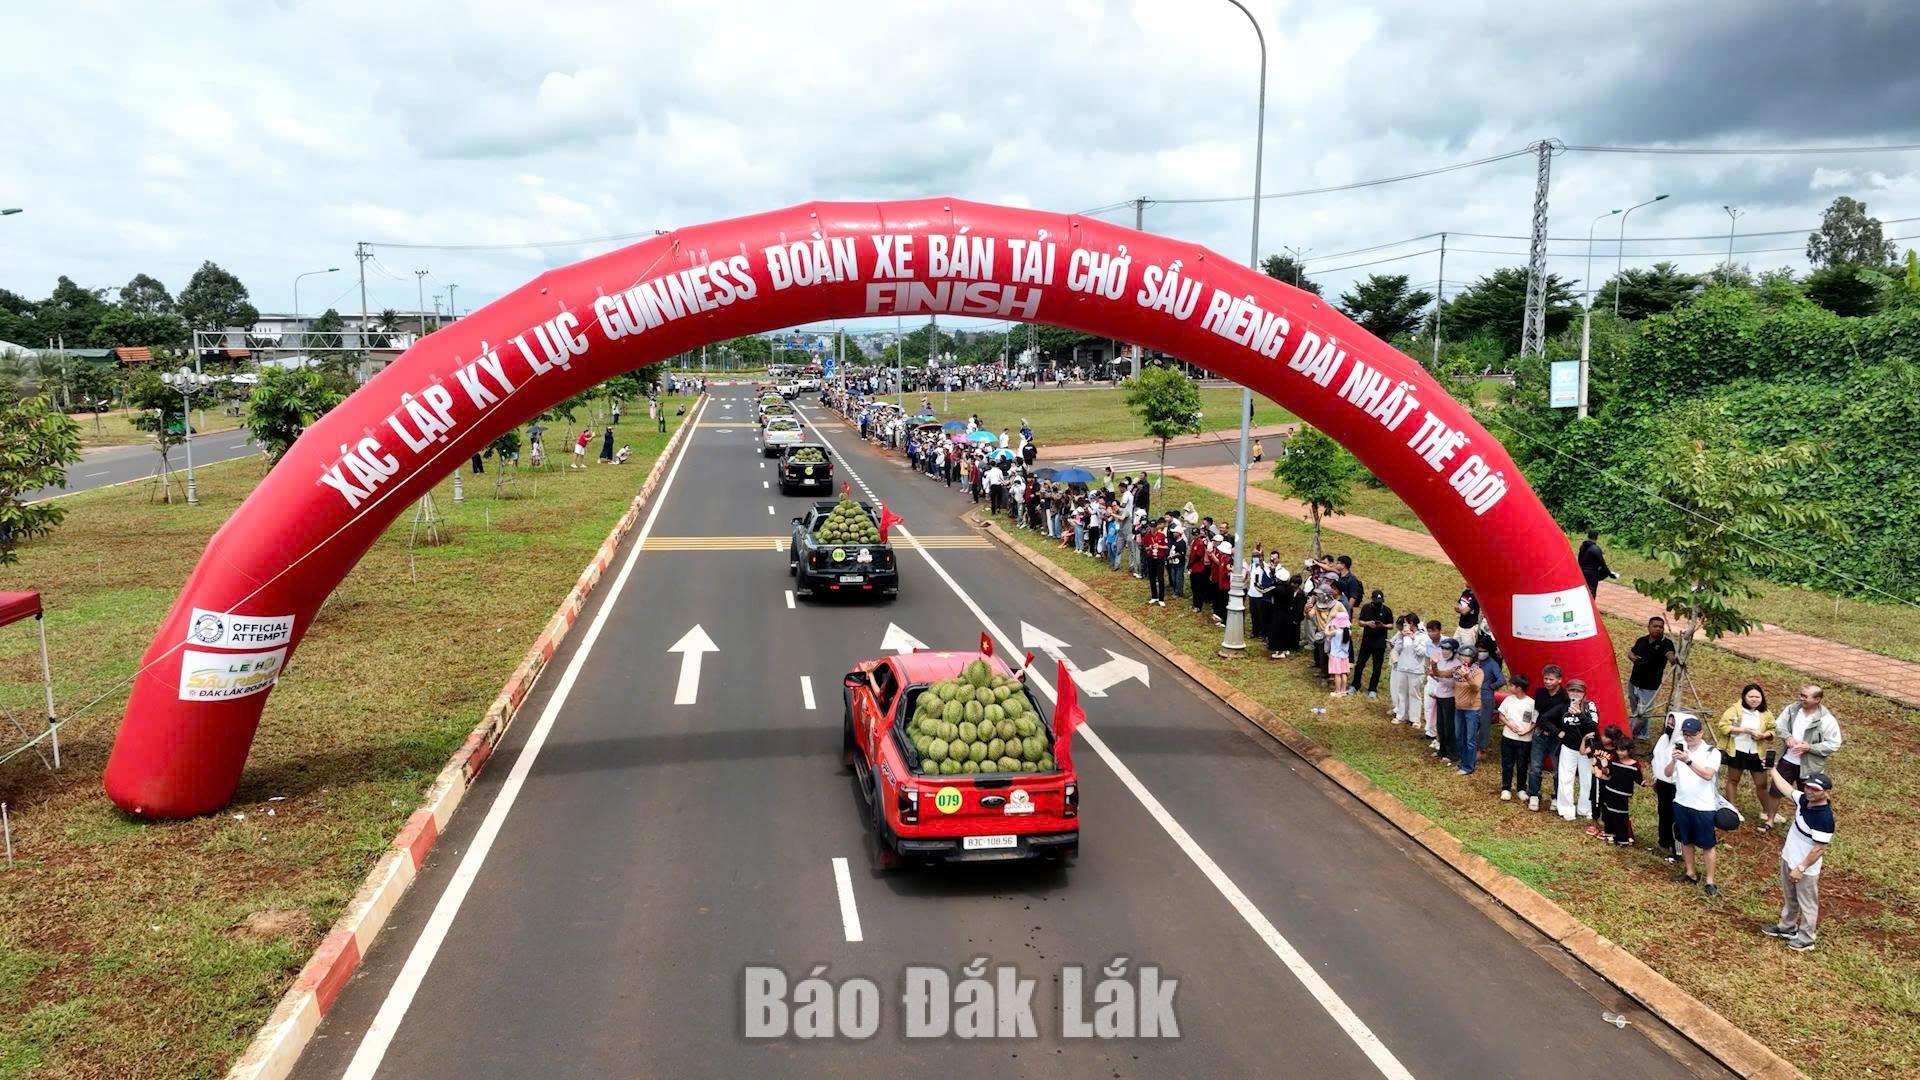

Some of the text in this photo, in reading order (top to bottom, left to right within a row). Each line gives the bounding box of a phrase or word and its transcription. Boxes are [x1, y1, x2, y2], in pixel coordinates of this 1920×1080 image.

[865, 281, 1043, 319] FINISH
[320, 443, 400, 509] XÁC
[387, 384, 457, 454] LẬP
[514, 312, 589, 376] LỤC
[594, 255, 758, 341] GUINNESS
[765, 231, 859, 291] ĐOÀN
[872, 235, 914, 279] XE
[928, 226, 995, 281] BÁN
[1008, 229, 1056, 285] TẢI
[1067, 245, 1132, 300] CHỞ
[1137, 259, 1203, 321] SẦU
[1200, 289, 1290, 360] RIÊNG
[1287, 330, 1347, 388] DÀI
[1337, 360, 1421, 432] NHẤT
[1407, 411, 1471, 473] THẾ
[1448, 454, 1508, 517] GIỚI
[232, 622, 289, 632] OFFICIAL
[231, 631, 288, 642] ATTEMPT
[938, 794, 960, 807] 079
